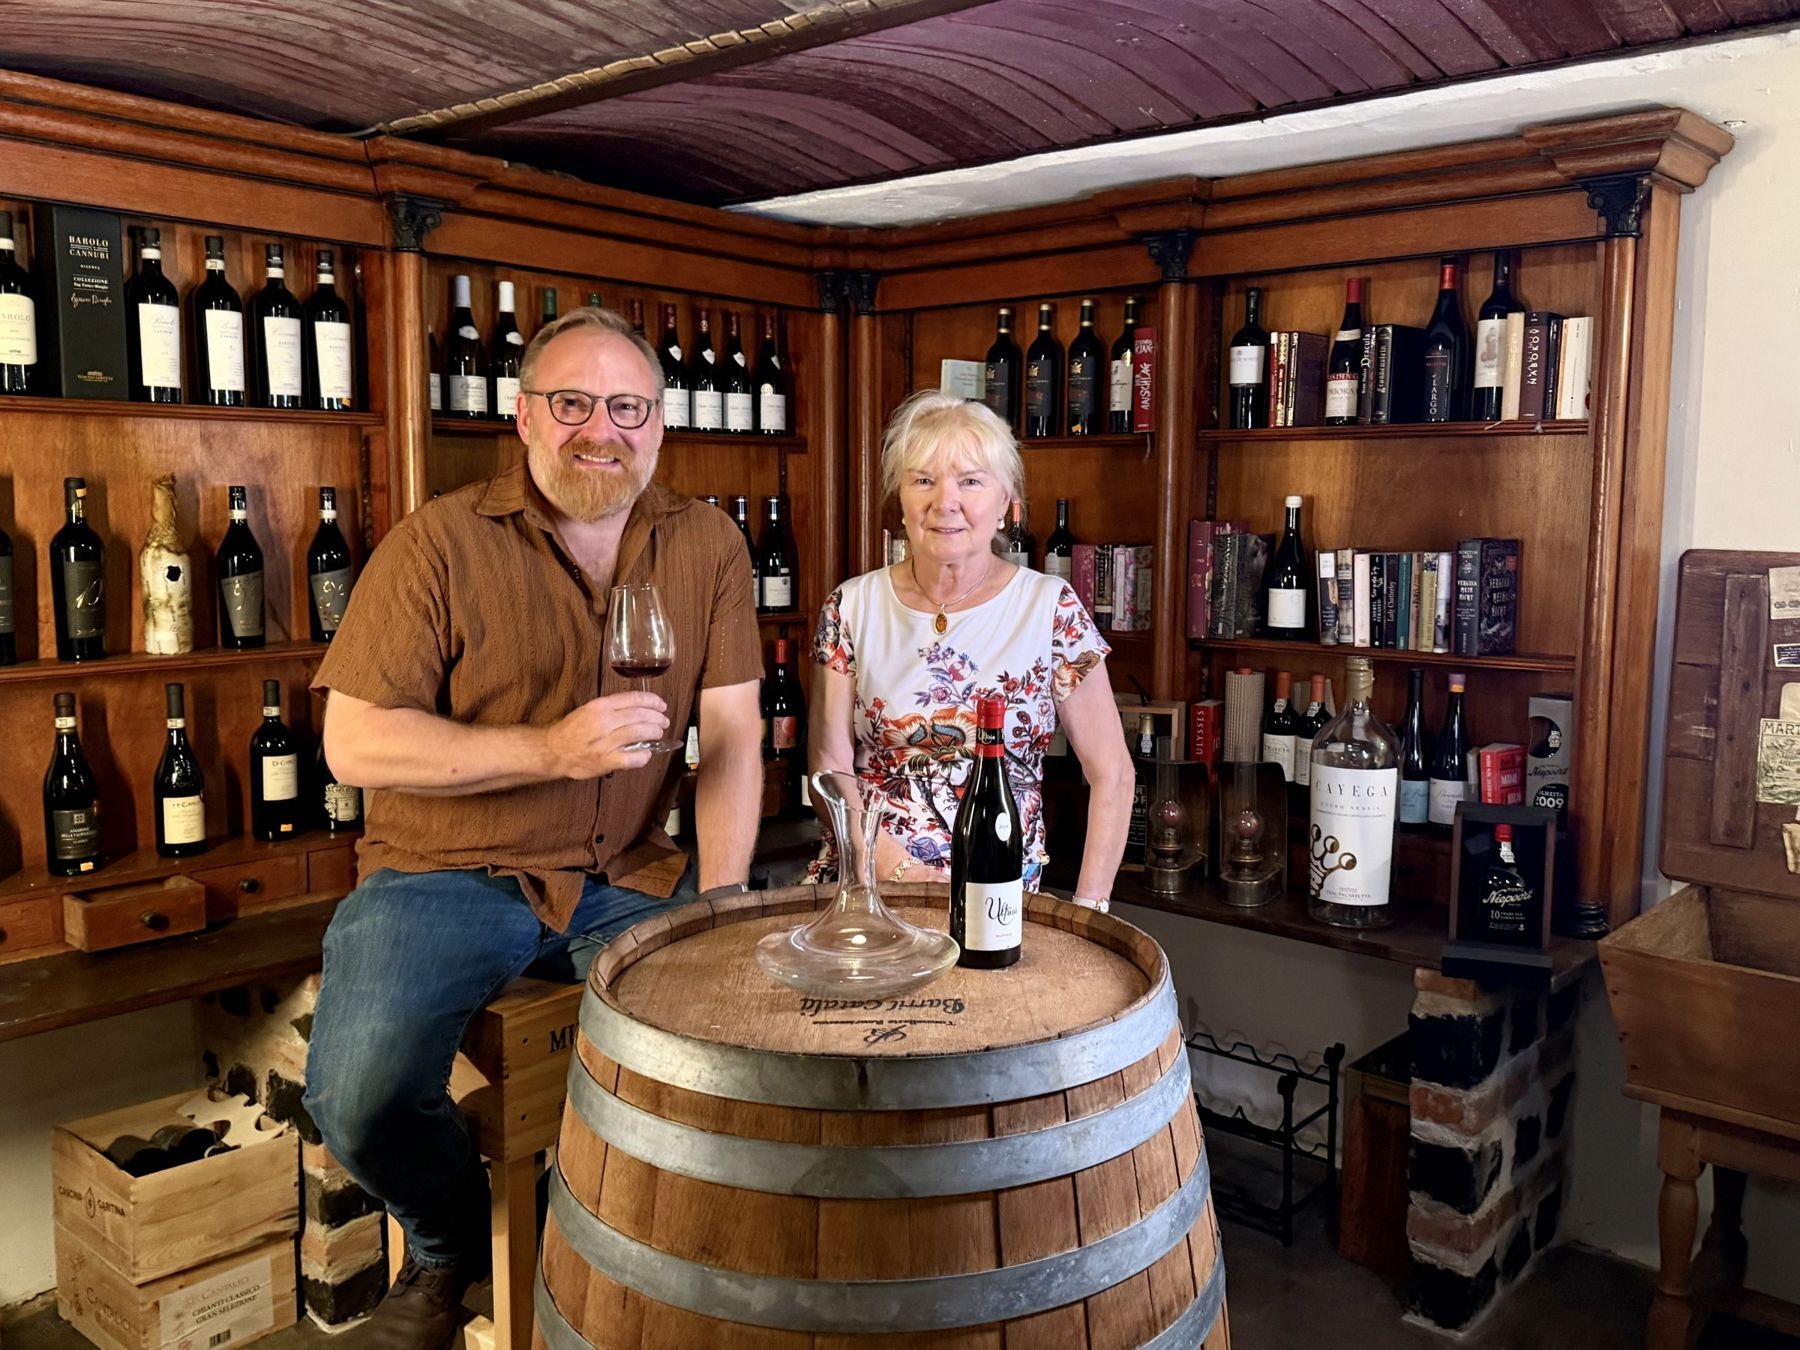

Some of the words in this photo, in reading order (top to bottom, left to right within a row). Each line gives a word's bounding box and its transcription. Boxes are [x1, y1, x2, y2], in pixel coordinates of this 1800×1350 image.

[69, 235, 109, 247] BAROLO
[69, 248, 109, 260] CANNUBI
[73, 276, 109, 285] COLLEZIONE
[0, 312, 31, 322] AROLO
[1360, 333, 1371, 368] Dracula
[1530, 328, 1540, 385] NABOKOV
[1140, 362, 1152, 411] ANSCHLAG
[1195, 710, 1205, 755] ULYSSES
[1315, 780, 1388, 798] CAYEGA
[1482, 889, 1534, 908] Niepoort
[1490, 910, 1501, 919] 10
[882, 998, 965, 1015] Barril
[549, 1022, 580, 1054] MI
[192, 1297, 225, 1317] CHIANTI
[225, 1284, 260, 1303] CLASSICO
[196, 1309, 218, 1324] GRAN
[219, 1295, 257, 1314] SELEZIONE
